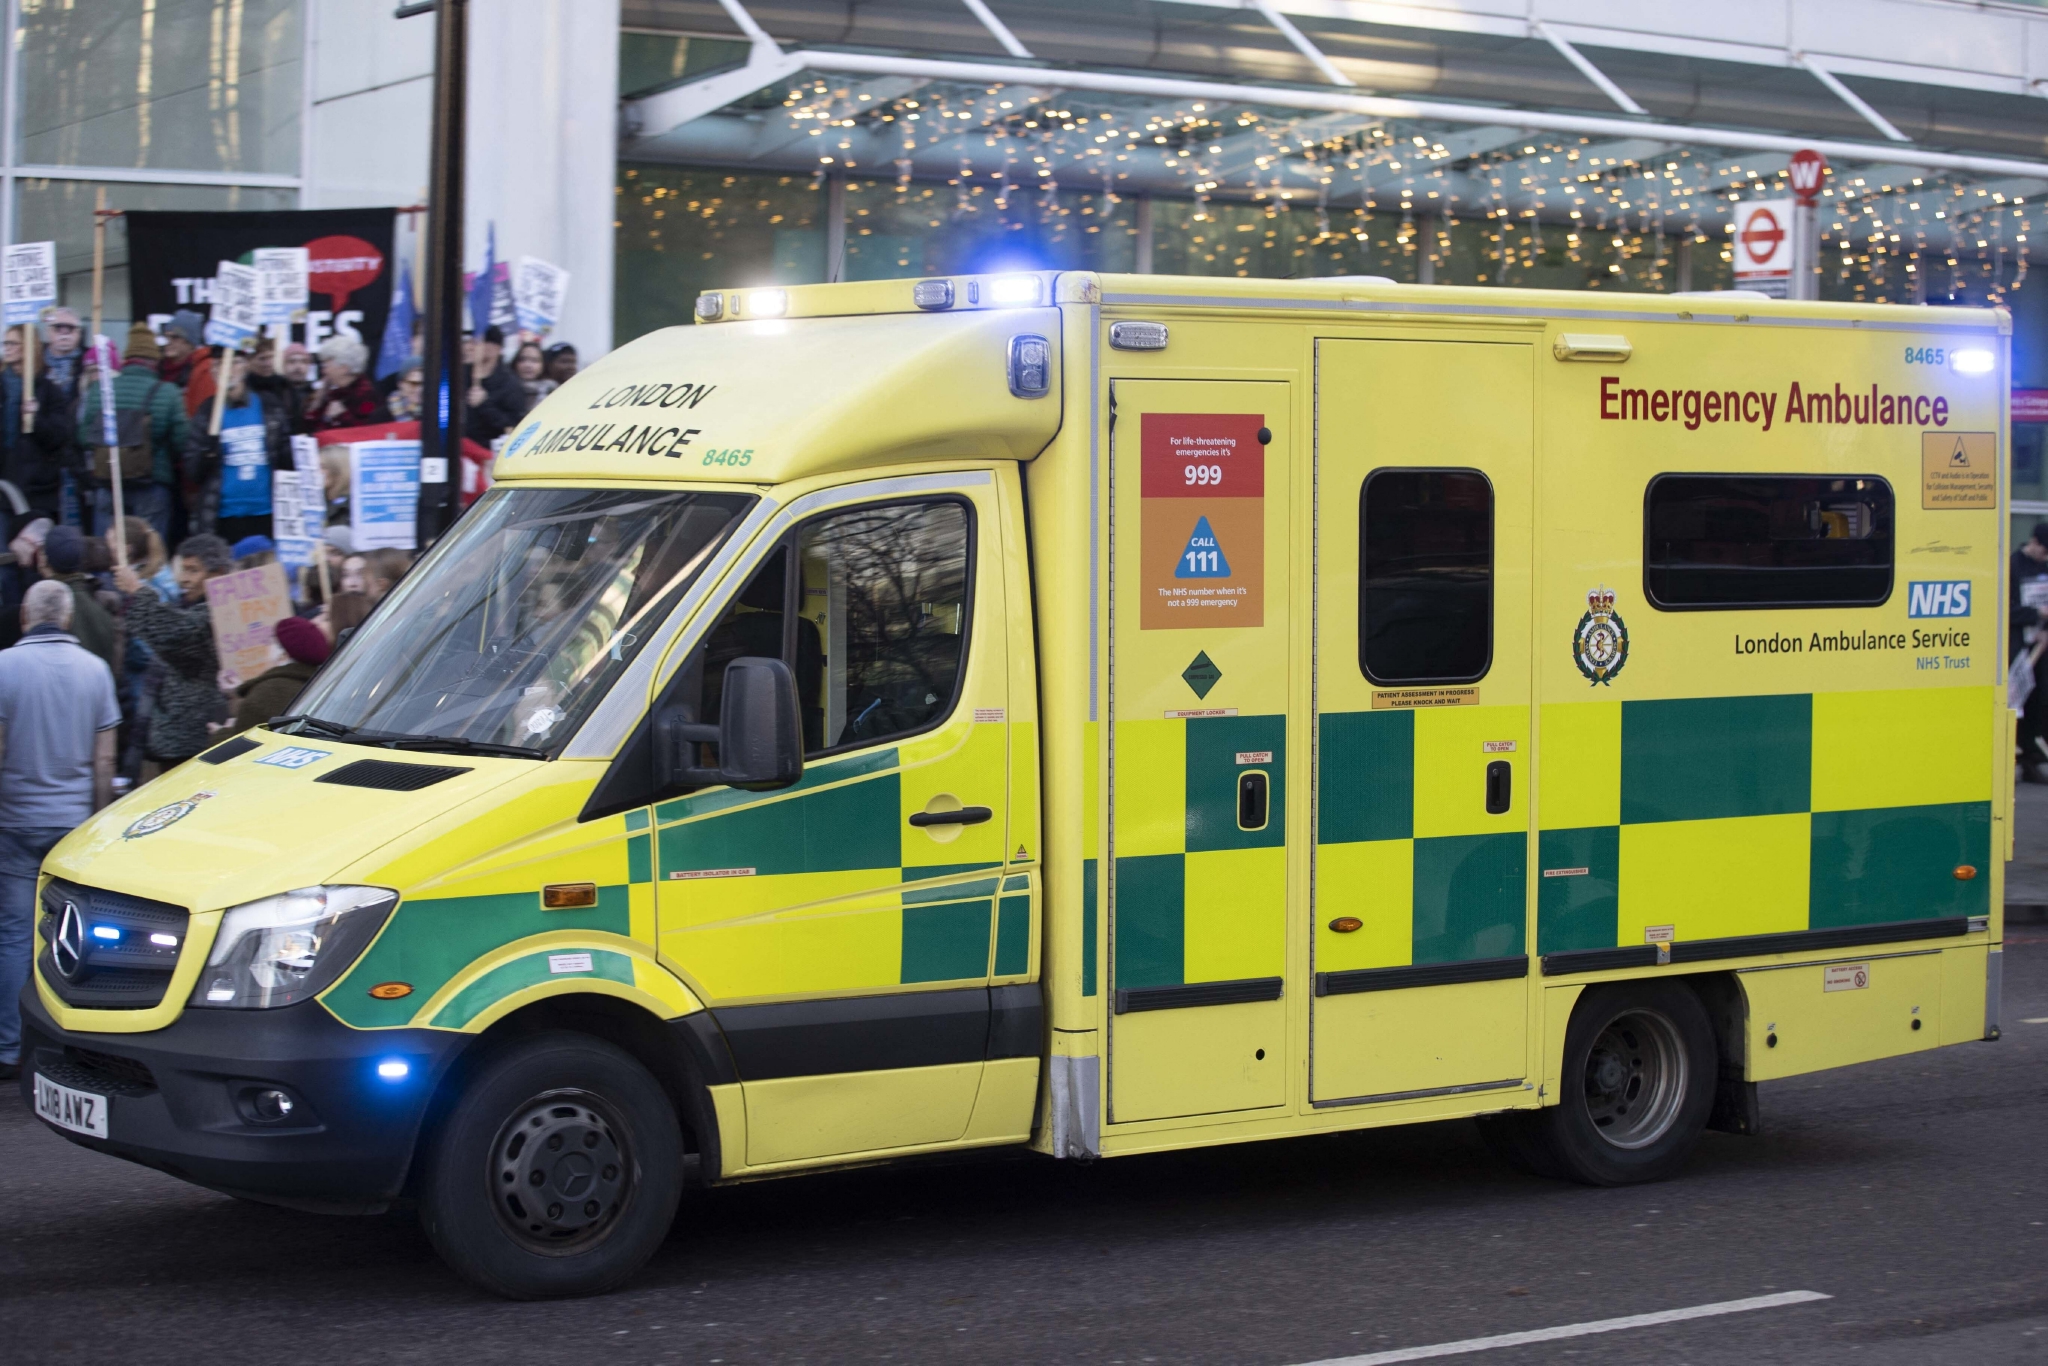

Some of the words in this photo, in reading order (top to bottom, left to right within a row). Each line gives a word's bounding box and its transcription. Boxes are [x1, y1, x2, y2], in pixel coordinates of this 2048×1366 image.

[1790, 161, 1820, 189] W
[171, 277, 216, 304] TH
[1904, 347, 1944, 365] 8465
[588, 383, 717, 409] LONDON
[1600, 376, 1777, 432] Emergency
[1785, 381, 1949, 427] Ambulance
[524, 423, 702, 458] AMBULANCE
[1170, 436, 1181, 446] For
[1182, 436, 1236, 448] life-threatening
[702, 449, 754, 467] 8465
[1176, 449, 1219, 458] emergencies
[1184, 465, 1222, 485] 999
[1191, 537, 1215, 547] CALL
[1185, 551, 1218, 572] 111
[1158, 588, 1171, 596] The
[1172, 588, 1187, 596] NHS
[1188, 587, 1215, 596] number
[1216, 587, 1236, 595] when
[1909, 582, 1970, 616] NHS
[1167, 599, 1180, 607] not
[1186, 598, 1199, 607] 999
[1200, 598, 1238, 608] emergency
[1735, 632, 1802, 655] London
[1808, 629, 1906, 652] Ambulance
[1912, 627, 1970, 649] Service
[1916, 656, 1940, 670] NHS
[1943, 655, 1970, 669] Trust
[256, 748, 327, 768] NHS
[64, 1093, 95, 1130] AWZ
